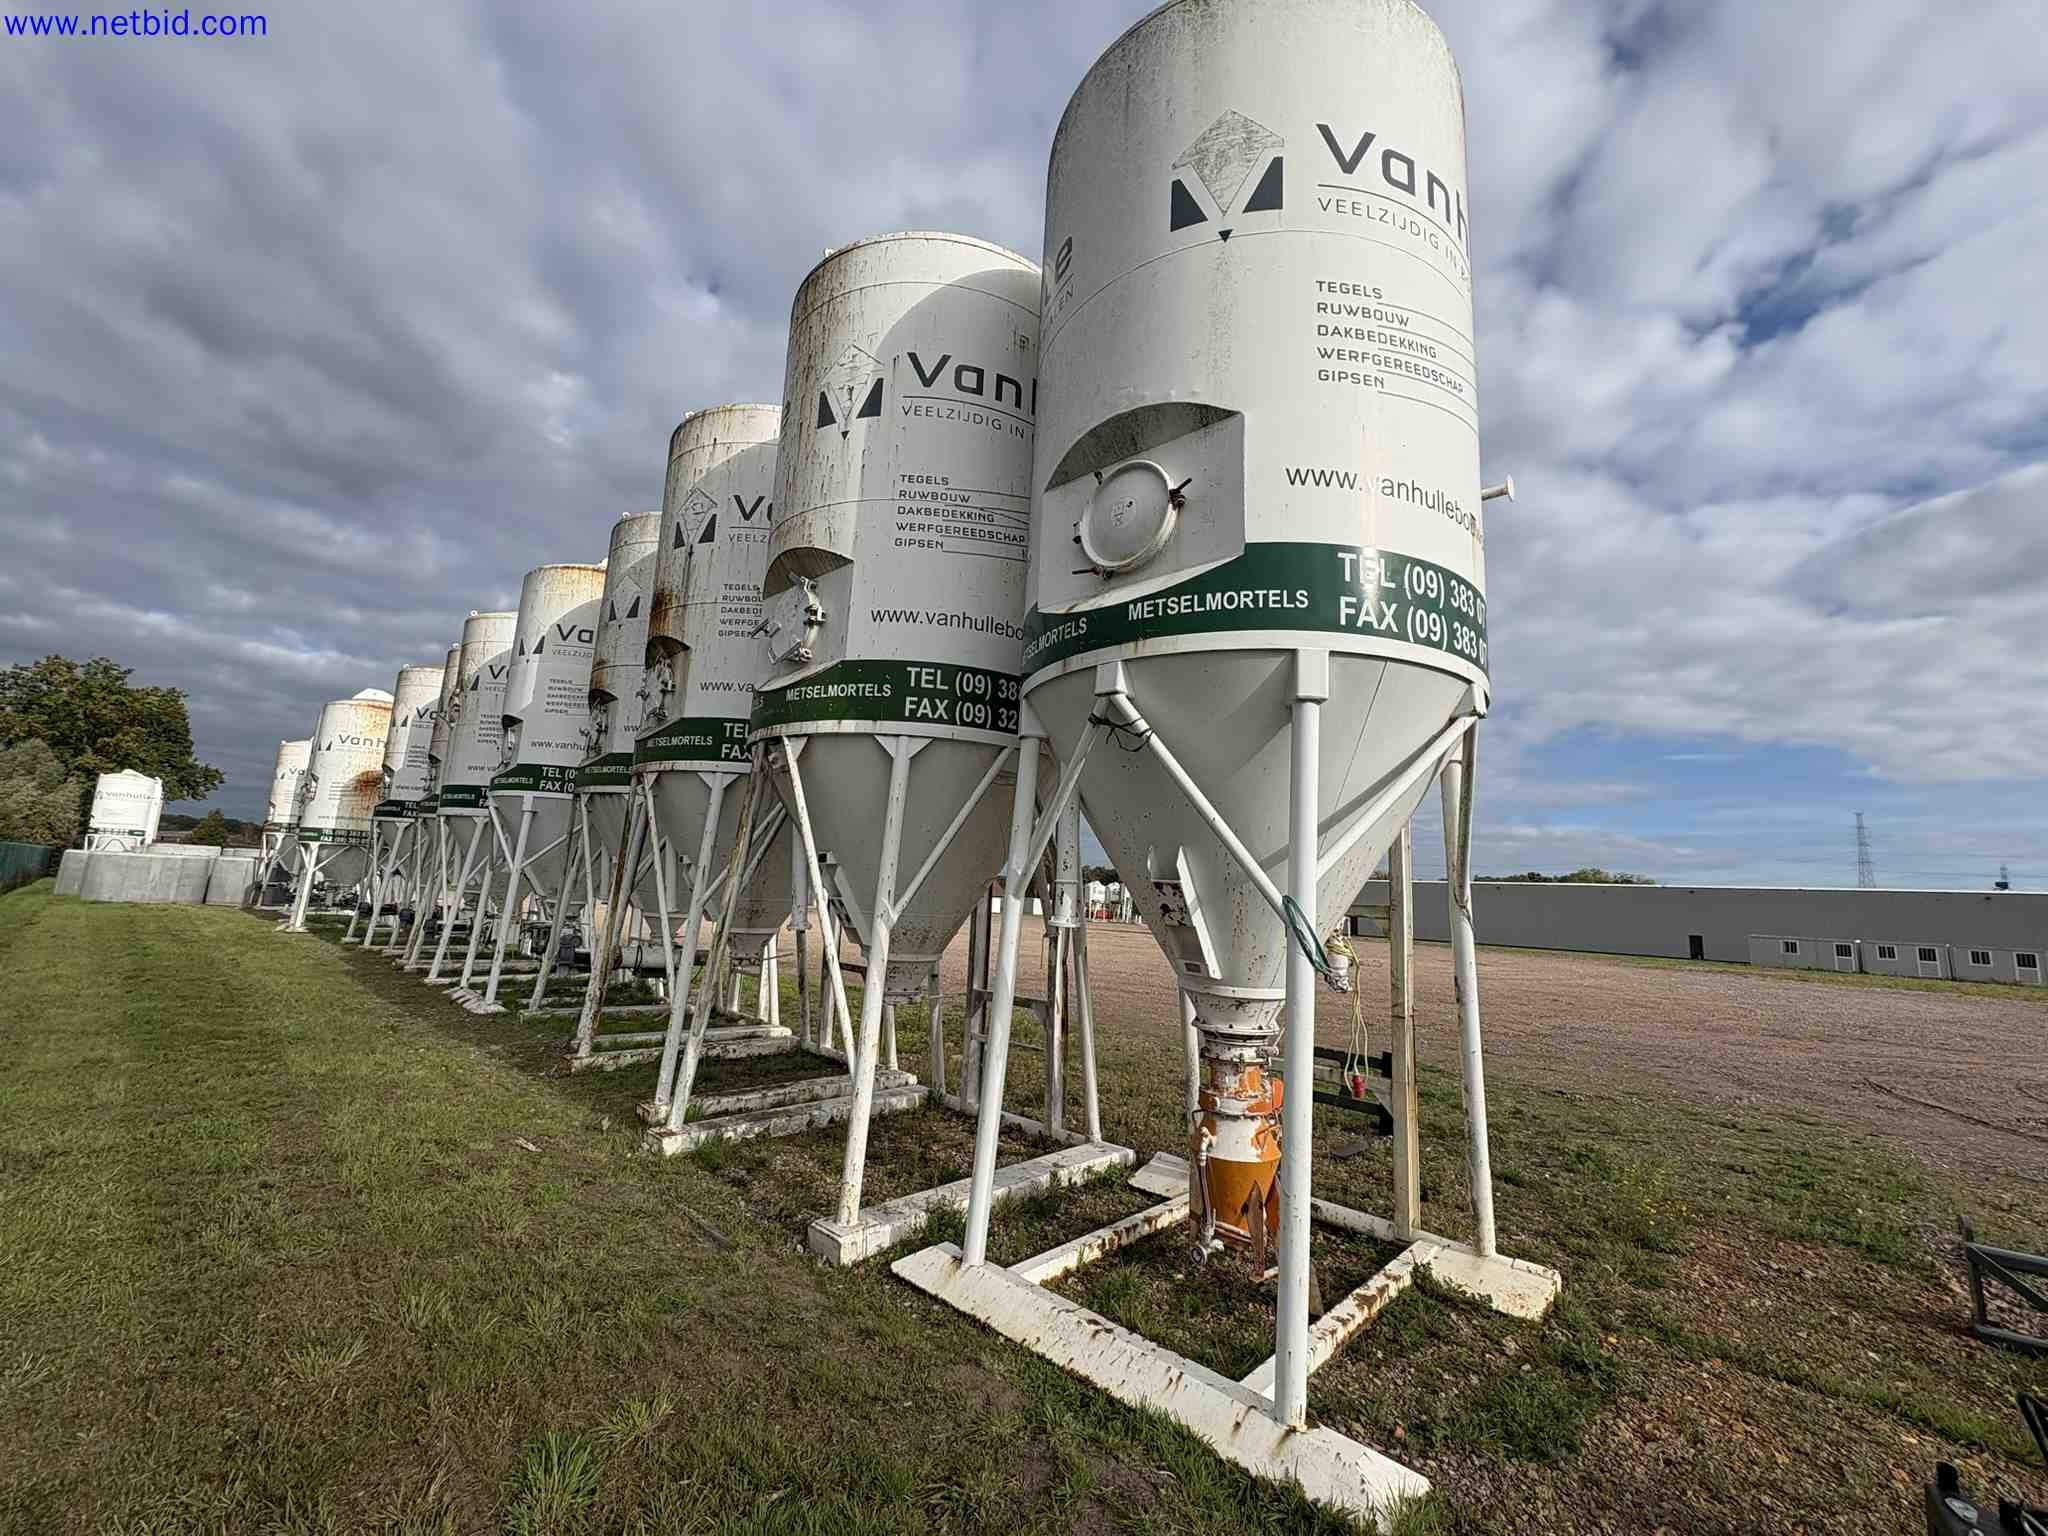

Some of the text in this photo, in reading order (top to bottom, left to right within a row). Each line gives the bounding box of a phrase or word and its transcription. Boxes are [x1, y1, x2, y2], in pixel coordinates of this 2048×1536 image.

[1317, 197, 1439, 250] VEELZIJDIG
[1315, 279, 1384, 300] TEGELS
[1316, 301, 1410, 328] RUWBOUW
[1317, 324, 1437, 359] DAKBEDEKKING
[1317, 346, 1464, 393] WERFGEREEDSCHAP
[1318, 369, 1386, 389] GIPSEN
[901, 404, 1025, 440] VEELZIJDIG IN
[899, 474, 950, 487] TEGELS
[898, 489, 971, 504] RUWBOUW
[896, 505, 996, 523] DAKBEDEKKING
[893, 537, 944, 550] GIPSEN
[895, 521, 1026, 543] WERFGEREEDSCHAP
[1337, 552, 1396, 589] TEL
[1404, 562, 1445, 609] (09)
[1450, 579, 1474, 618] 383
[1128, 589, 1309, 622] METSELMORTELS
[1339, 595, 1398, 633] FAX
[1406, 605, 1448, 651] (09)
[1452, 621, 1477, 659] 383
[785, 683, 892, 702] METSELMORTELS
[906, 667, 1021, 701] TEL (09) 38
[904, 697, 948, 719] FAX
[955, 702, 991, 730] (09)
[541, 766, 562, 779] TEL
[539, 779, 561, 792] FAX
